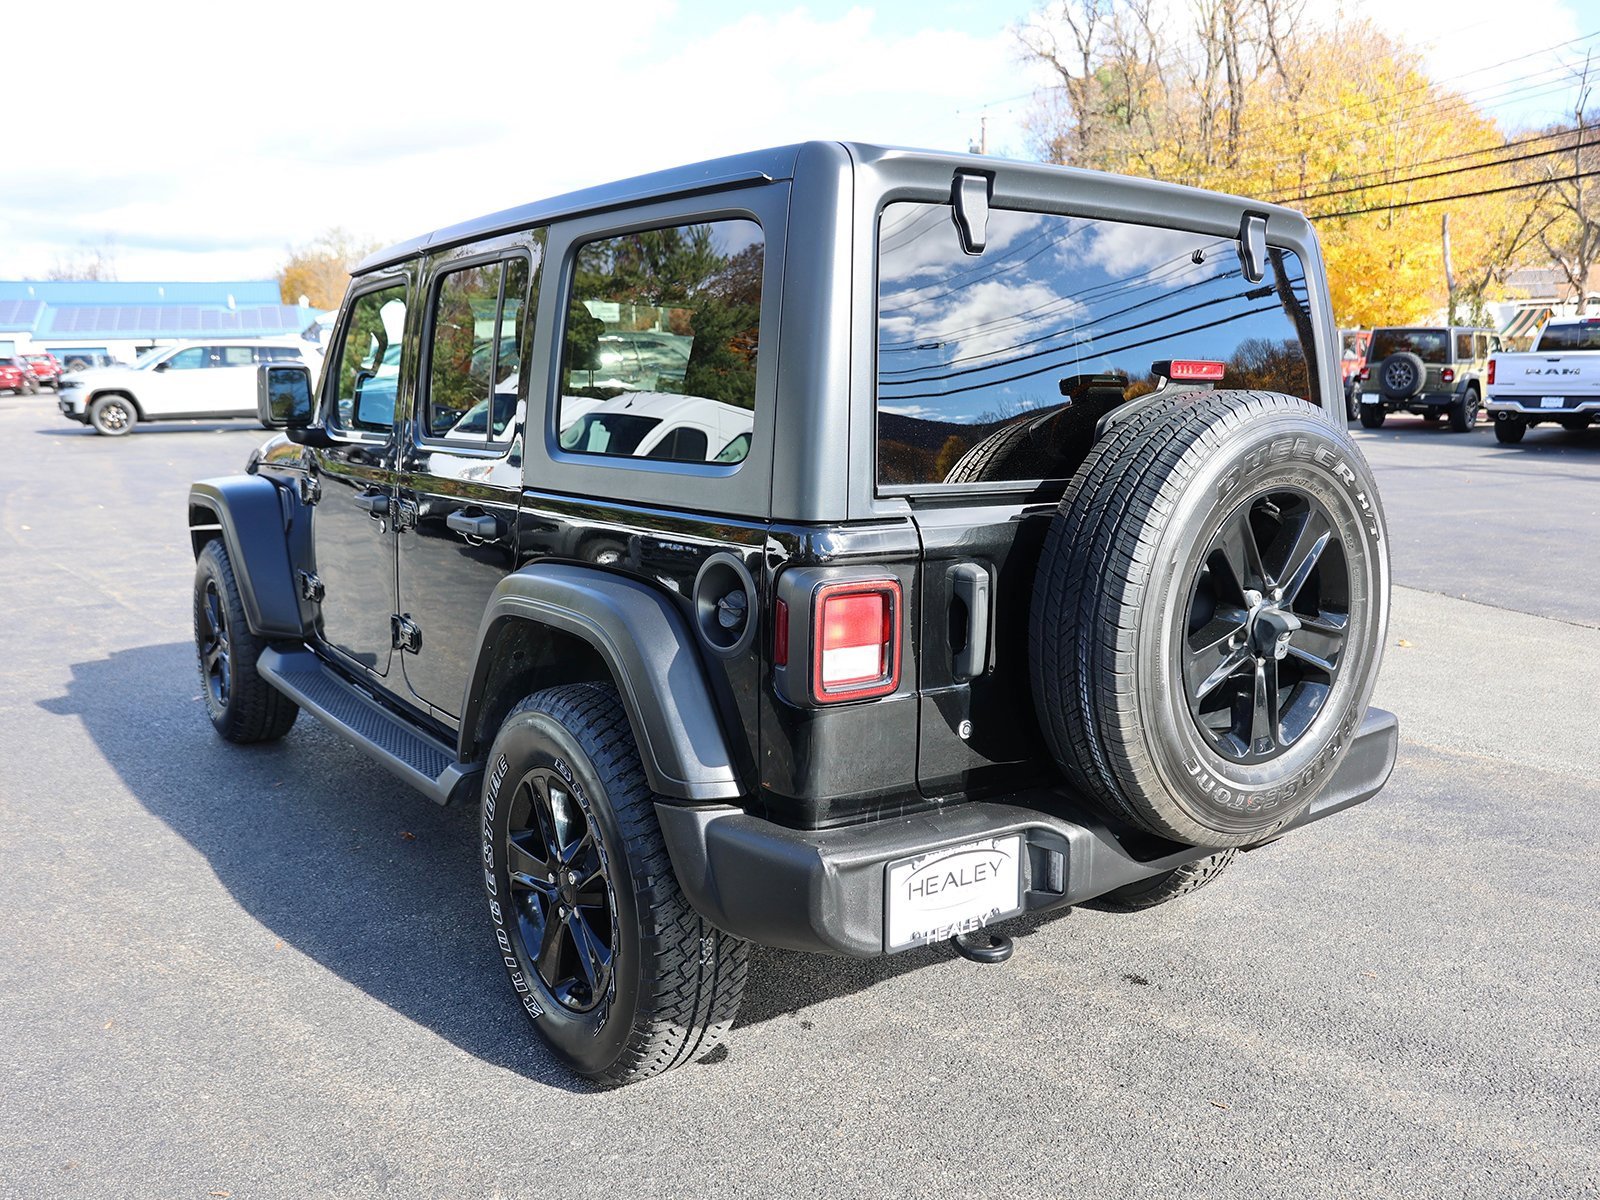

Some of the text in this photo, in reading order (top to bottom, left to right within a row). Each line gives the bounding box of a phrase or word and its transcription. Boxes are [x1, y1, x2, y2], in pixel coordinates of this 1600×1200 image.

[1217, 437, 1356, 505] DUELER
[1356, 490, 1381, 541] H/T
[1182, 703, 1358, 813] BRIDGESTONE
[482, 754, 544, 1019] BRIDGESTONE
[909, 858, 1003, 900] HEALEY
[927, 914, 989, 945] HEALEY
